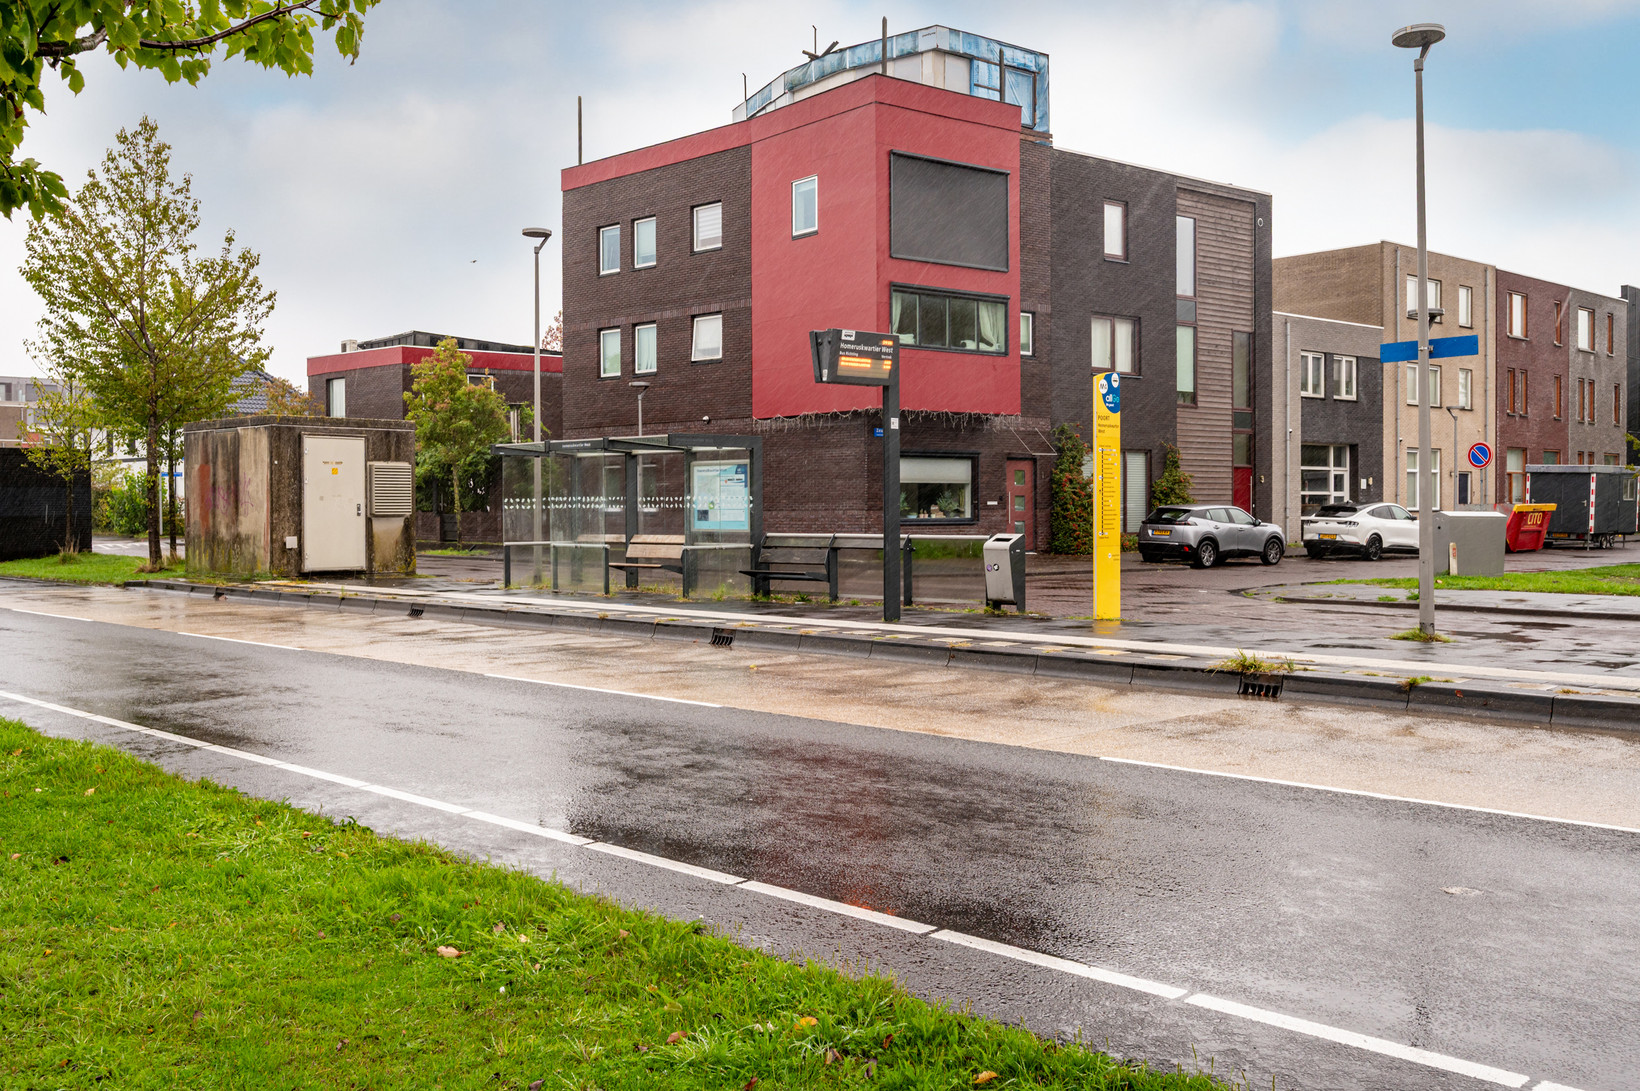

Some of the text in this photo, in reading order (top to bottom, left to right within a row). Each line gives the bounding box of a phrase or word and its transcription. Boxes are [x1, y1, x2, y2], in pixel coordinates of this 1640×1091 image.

[840, 342, 881, 352] Homeruskwartier
[1105, 394, 1119, 403] allGo
[1528, 512, 1543, 524] CITO
